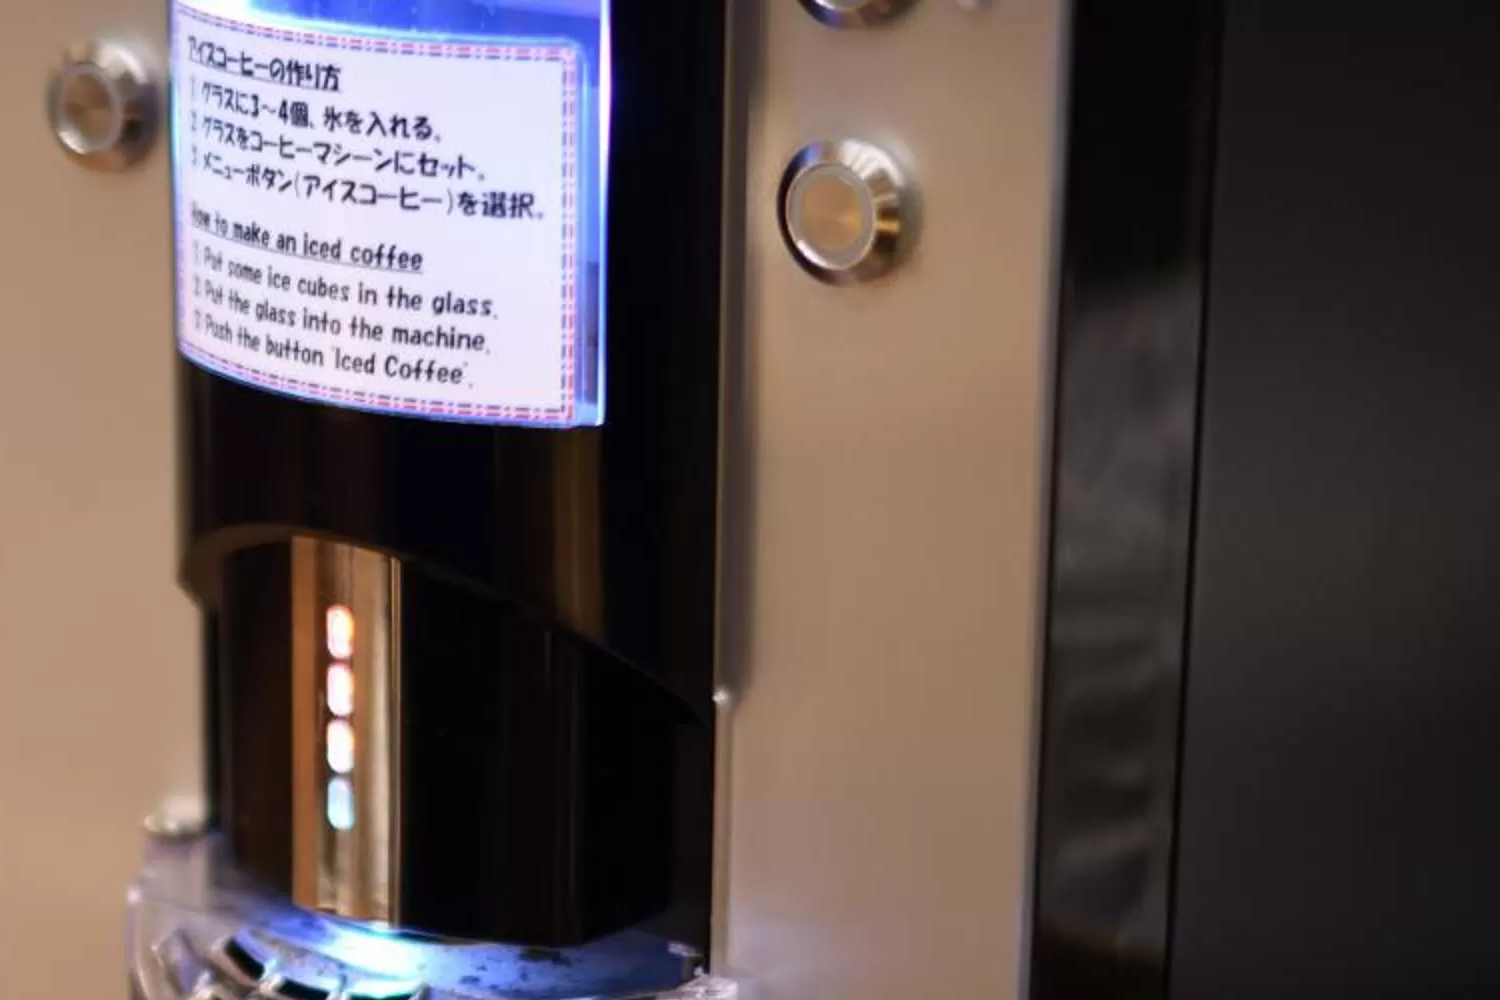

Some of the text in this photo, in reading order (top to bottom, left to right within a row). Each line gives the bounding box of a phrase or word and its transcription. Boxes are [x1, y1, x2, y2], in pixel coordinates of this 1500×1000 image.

[188, 35, 341, 92] アイスコーヒーの作り方
[215, 211, 229, 236] to
[233, 220, 270, 247] make
[276, 233, 297, 252] an
[303, 231, 342, 260] iced
[350, 243, 423, 271] coffee
[228, 259, 262, 285] some
[267, 265, 291, 291] ice
[297, 275, 350, 302] cubes
[358, 281, 378, 306] in
[386, 284, 423, 311] the
[432, 290, 498, 320] glass.
[204, 312, 233, 344] Push
[237, 325, 260, 352] the
[265, 332, 324, 367] button
[228, 288, 250, 315] the
[255, 297, 296, 327] glass
[303, 306, 341, 335] into
[348, 314, 383, 341] the
[391, 323, 491, 355] machine.
